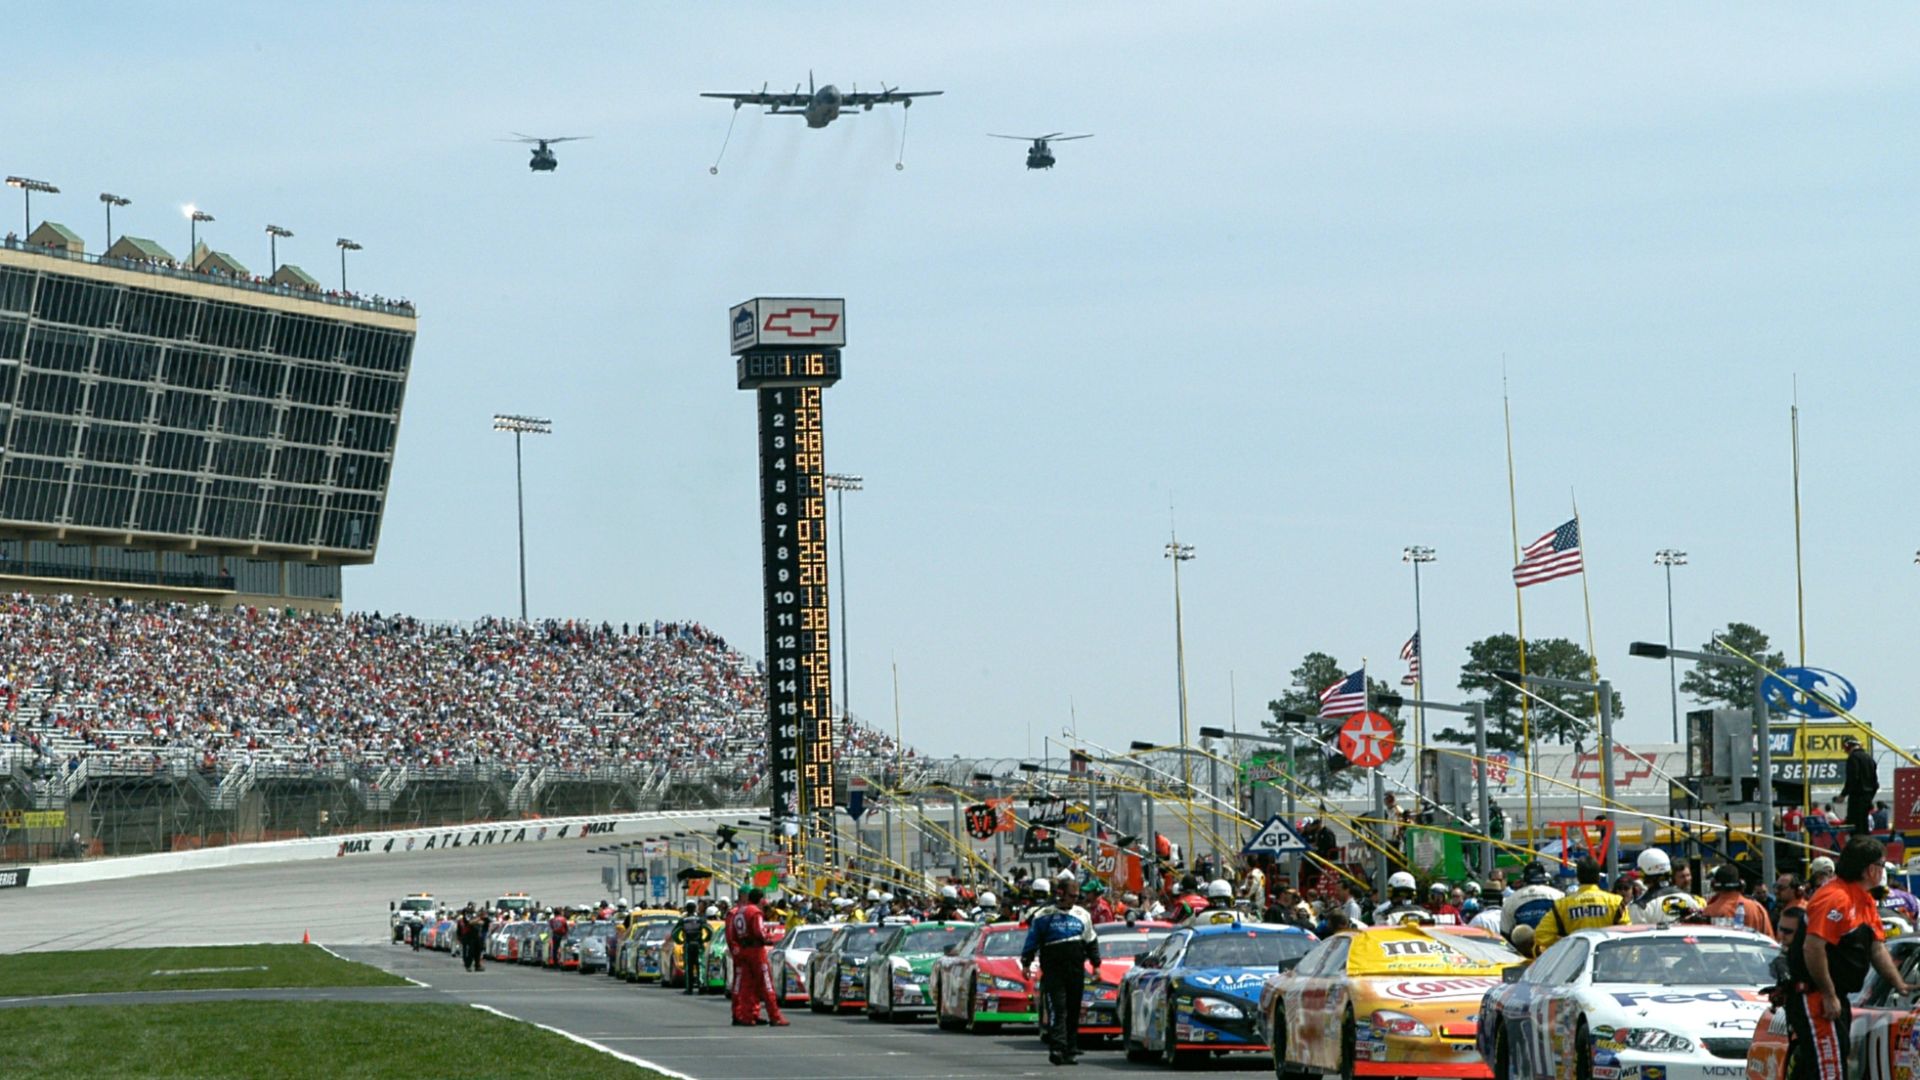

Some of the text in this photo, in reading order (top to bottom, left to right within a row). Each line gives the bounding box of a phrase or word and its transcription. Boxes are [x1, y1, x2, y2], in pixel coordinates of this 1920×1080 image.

[805, 354, 824, 375] 16
[774, 386, 820, 407] 1 12
[773, 409, 821, 430] 2 32
[774, 431, 822, 452] 3 48
[774, 453, 822, 474] 4 99
[776, 475, 823, 496] 5 9
[775, 498, 824, 518] 6 16
[777, 519, 825, 541] 7 01
[777, 542, 825, 562] 8 25
[778, 564, 826, 585] 9 20
[774, 591, 794, 603] 10
[777, 608, 827, 629] 11 38
[776, 631, 828, 651] 12 6
[777, 652, 829, 674] 13 42
[777, 680, 796, 693] 14
[778, 697, 830, 718] 15 41
[779, 719, 831, 740] 16 0
[780, 742, 831, 763] 17 10
[780, 770, 798, 783] 18
[805, 764, 832, 785] 91
[814, 786, 833, 807] 18
[383, 838, 395, 852] 4
[424, 828, 527, 850] ATLANTA
[557, 825, 570, 839] 4
[1262, 832, 1291, 847] GP
[1096, 856, 1115, 873] 20
[1703, 1066, 1746, 1076] MONT
